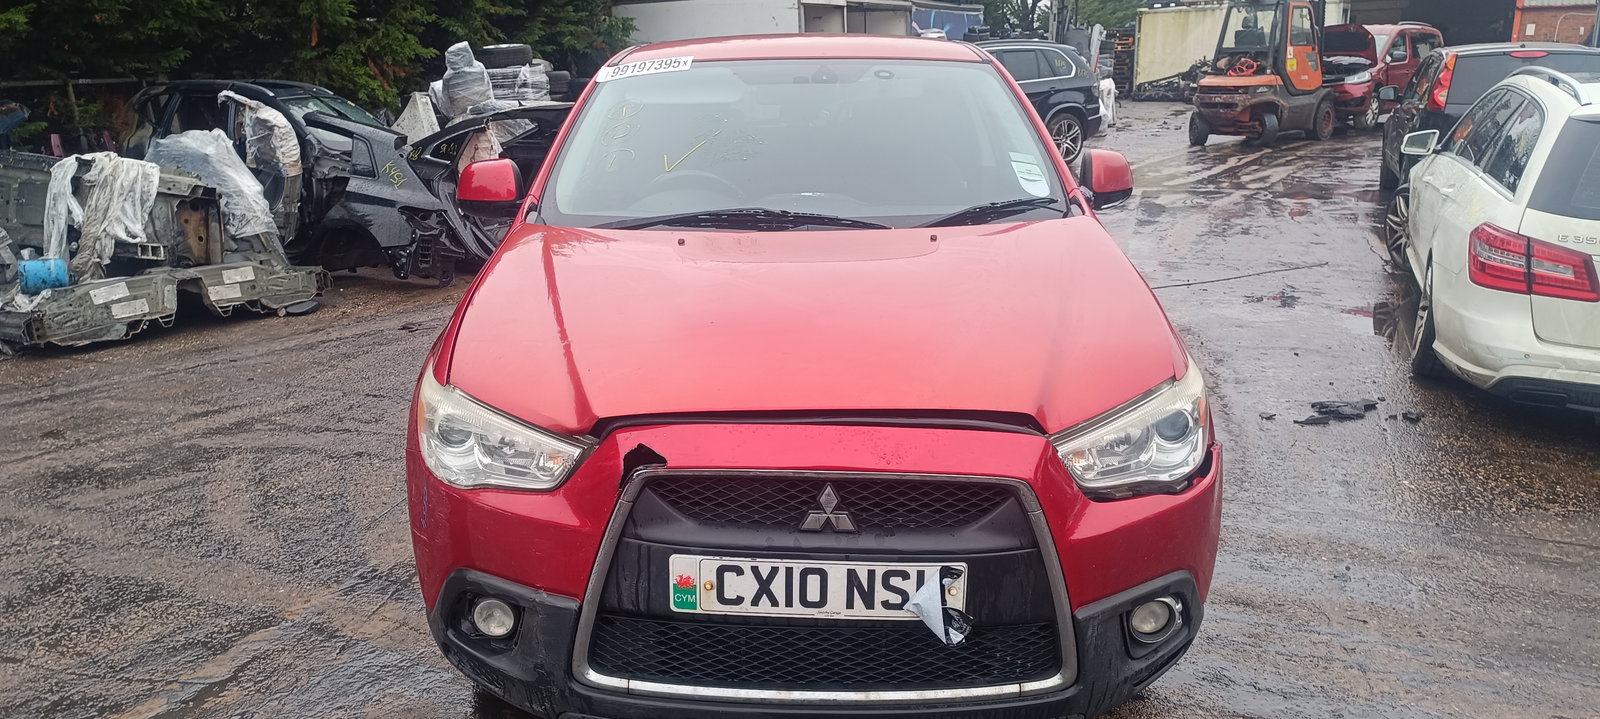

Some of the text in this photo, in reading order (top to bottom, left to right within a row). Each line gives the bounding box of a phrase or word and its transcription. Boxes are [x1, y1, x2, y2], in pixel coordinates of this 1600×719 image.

[1573, 235, 1600, 244] 35
[715, 564, 828, 609] CX10
[675, 593, 696, 603] CYM
